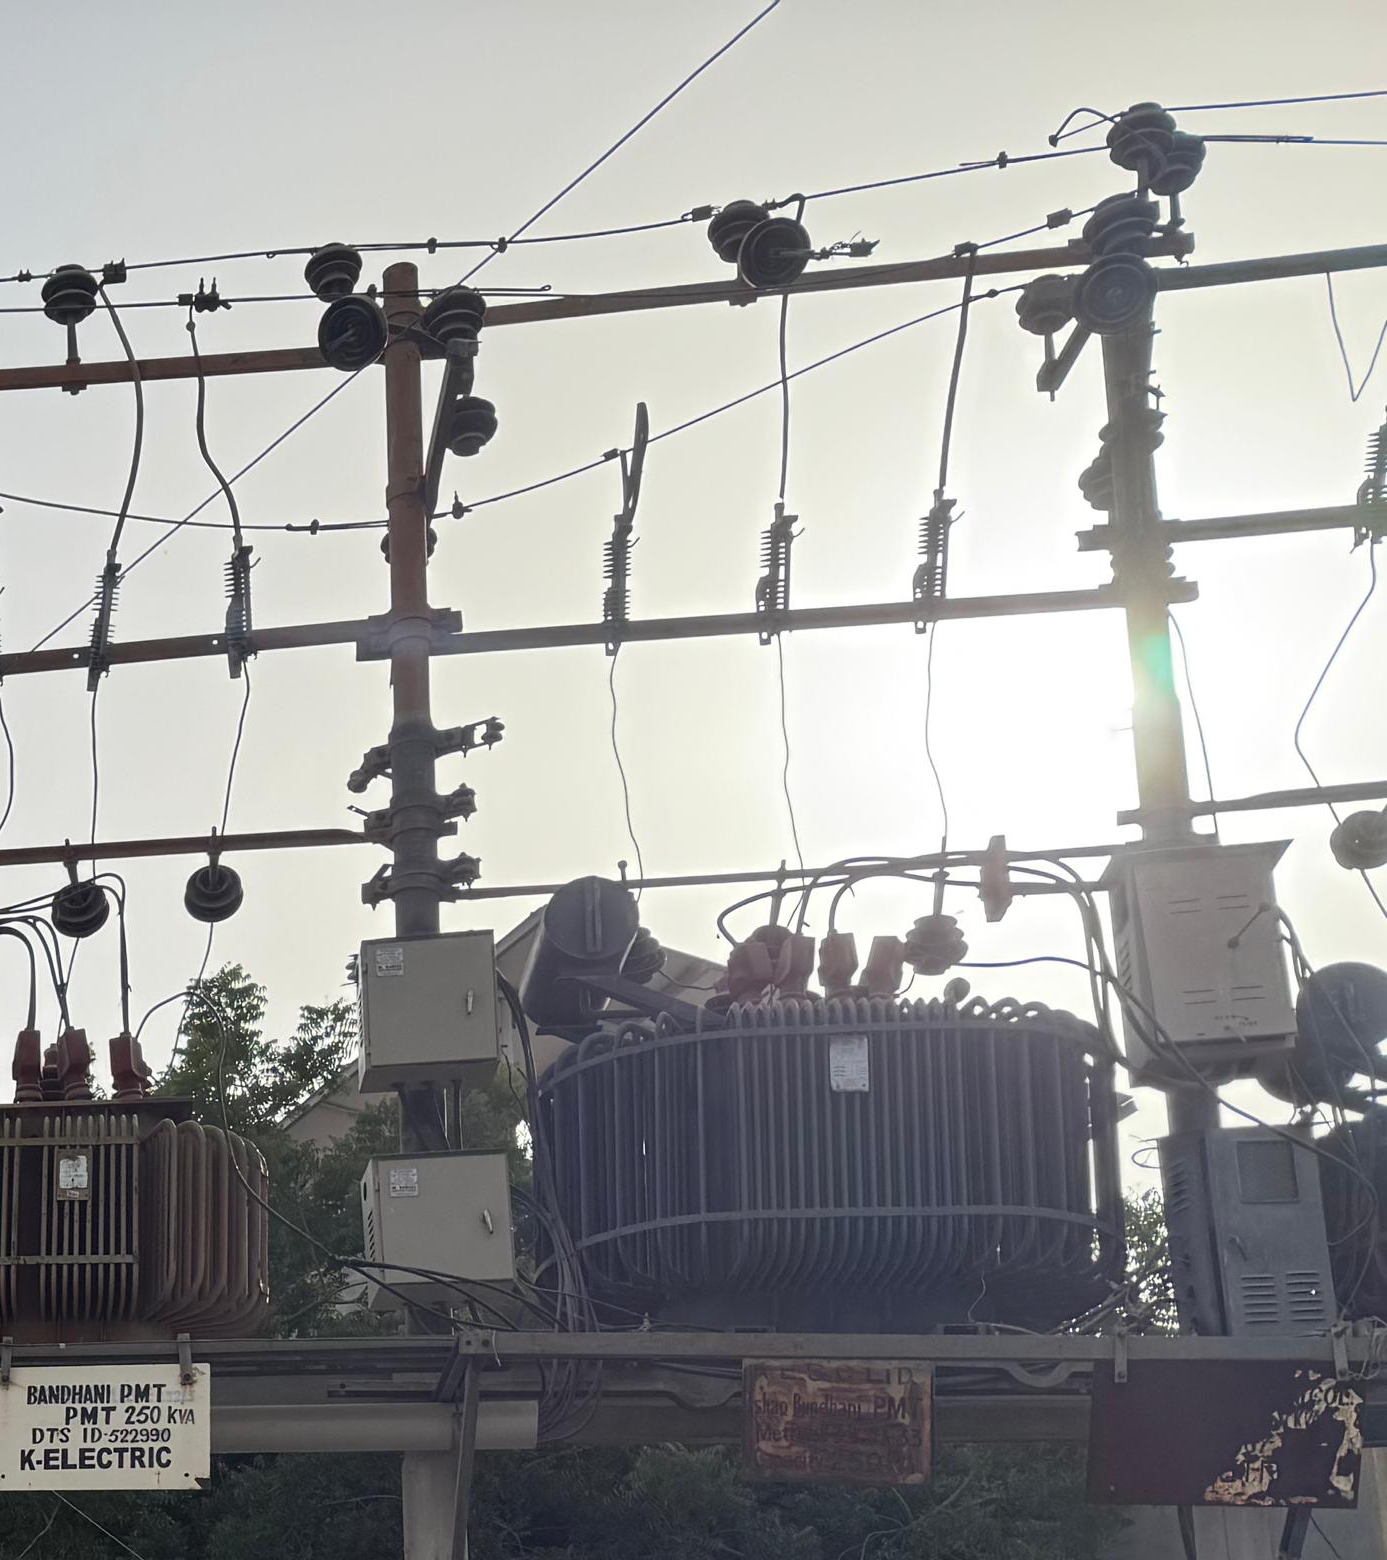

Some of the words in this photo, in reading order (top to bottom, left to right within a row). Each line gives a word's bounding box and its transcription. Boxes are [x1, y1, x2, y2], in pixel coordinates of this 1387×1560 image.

[27, 1384, 110, 1405] BANDHANI
[120, 1384, 167, 1403] PMT
[64, 1406, 116, 1426] PMT
[125, 1406, 161, 1425] 250
[32, 1428, 70, 1444] DTS
[83, 1427, 171, 1443] ID-522990
[20, 1447, 172, 1471] K-ELECTRIC
